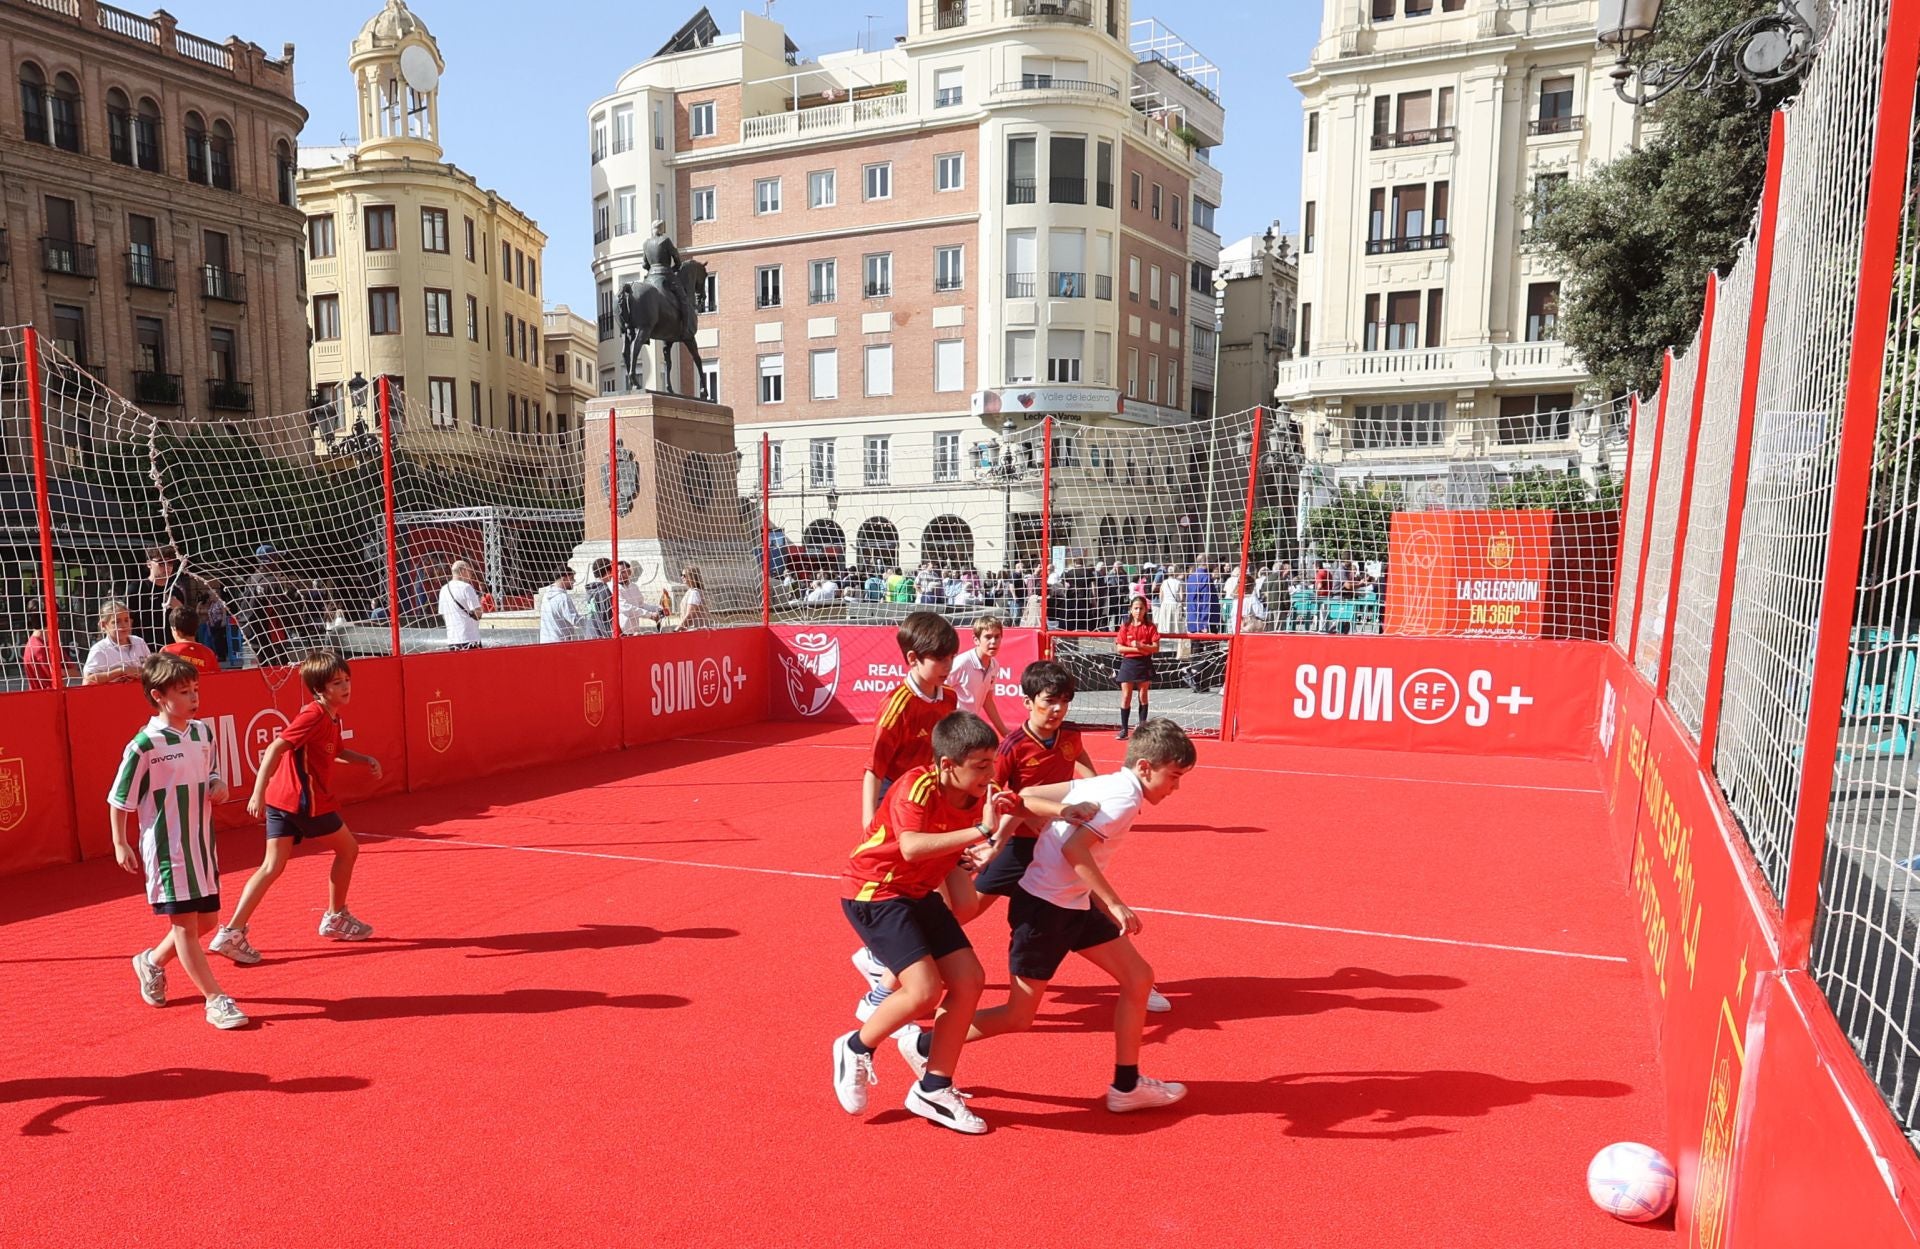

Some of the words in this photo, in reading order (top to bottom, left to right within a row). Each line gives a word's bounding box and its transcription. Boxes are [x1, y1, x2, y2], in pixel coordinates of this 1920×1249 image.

[1042, 391, 1064, 401] Valle
[1066, 391, 1077, 401] de
[1457, 580, 1471, 600] LA
[1472, 577, 1538, 601] SELECCIÓN
[1470, 604, 1486, 624] EN
[868, 664, 907, 677] REAL
[1628, 723, 1664, 832] SELECIÓN
[1639, 855, 1670, 1000] FÚTBOL
